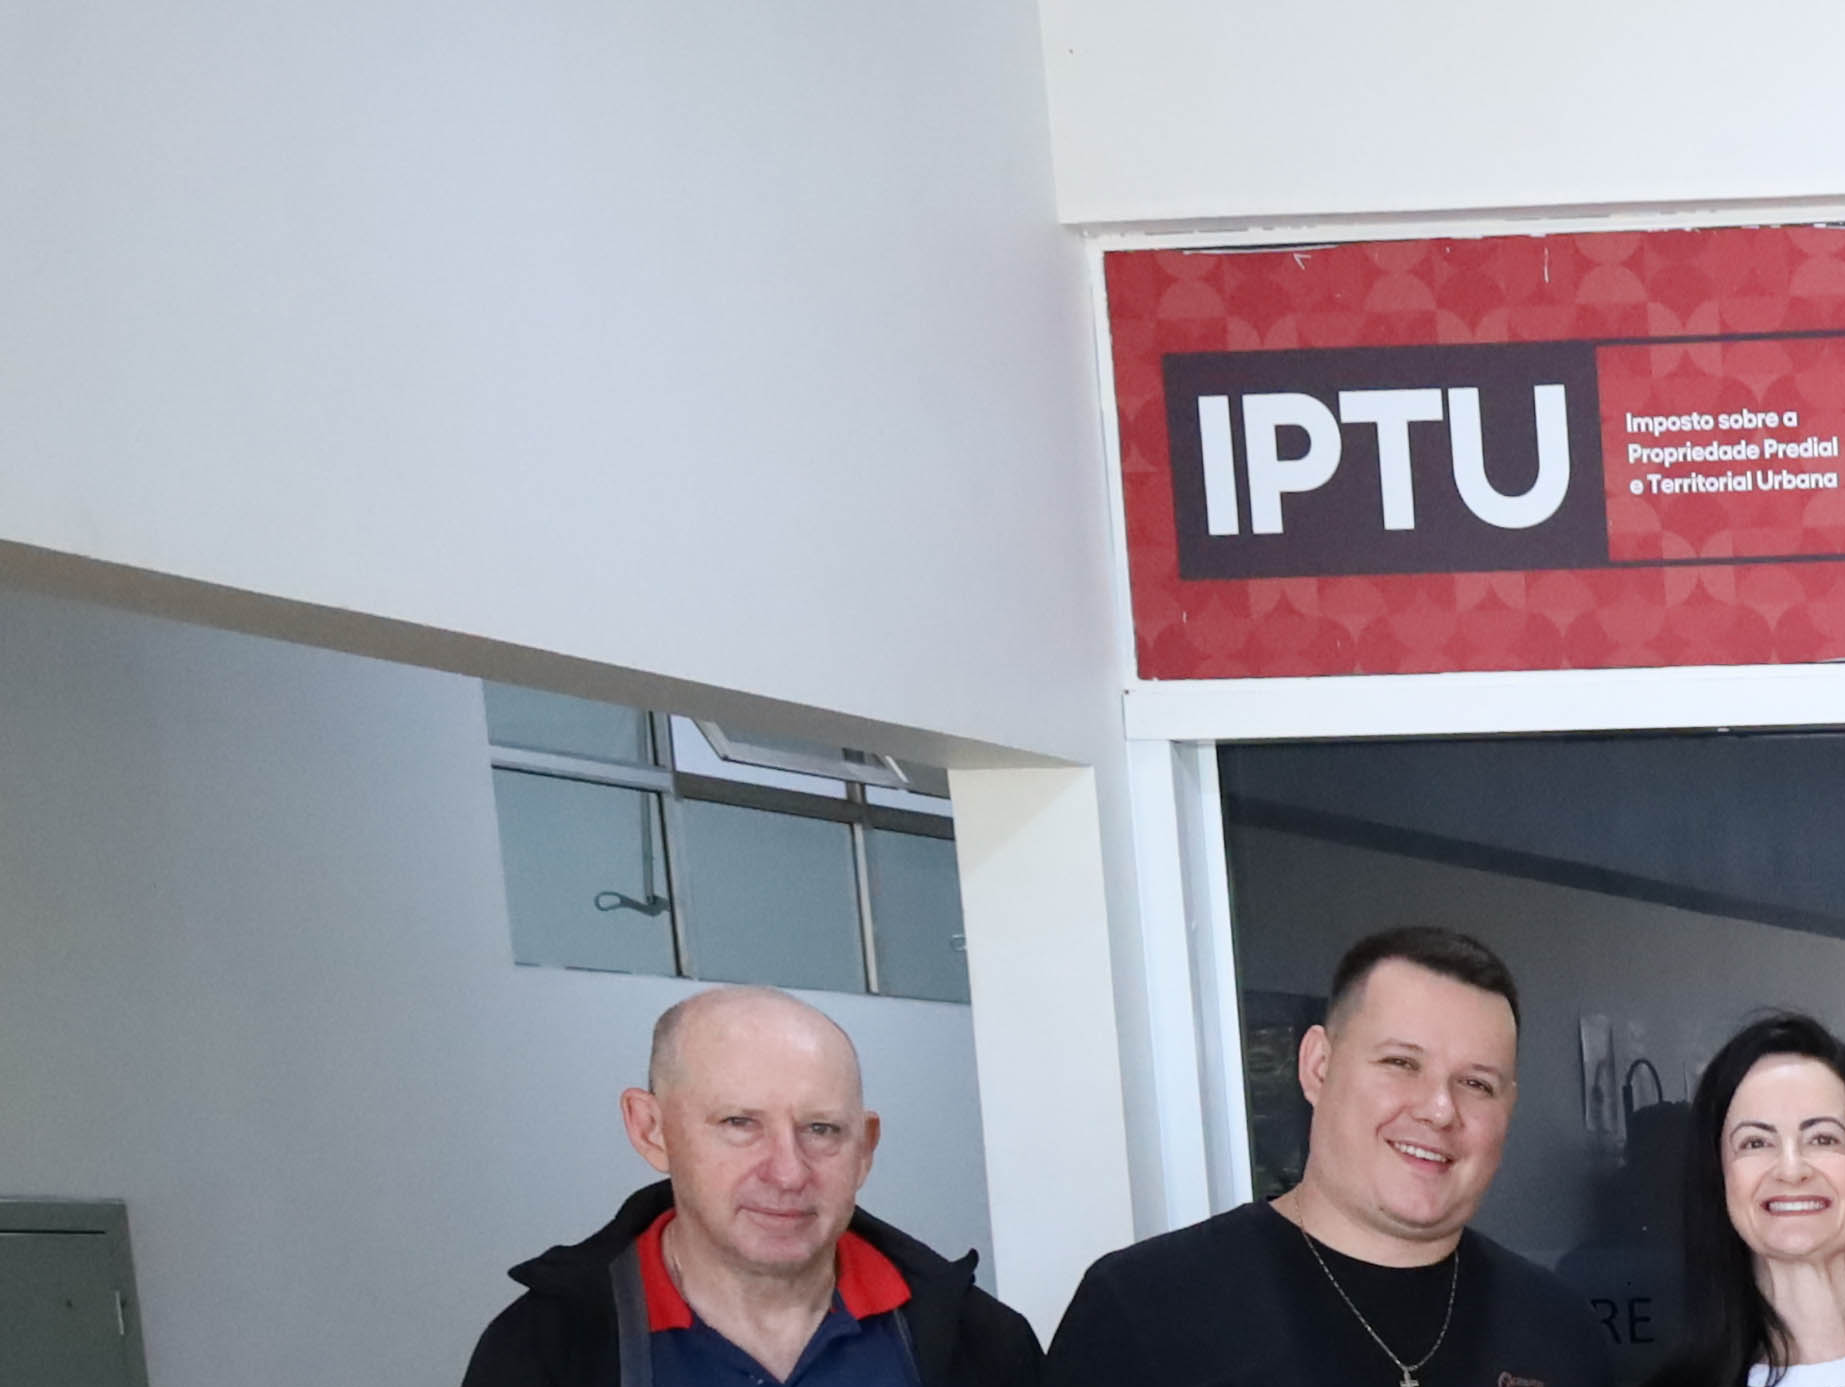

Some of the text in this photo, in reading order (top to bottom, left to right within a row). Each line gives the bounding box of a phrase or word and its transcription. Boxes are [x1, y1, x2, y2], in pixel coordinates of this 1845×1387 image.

[1626, 408, 1798, 437] Imposto sobre a
[1198, 383, 1570, 536] IPTU
[1628, 436, 1838, 467] Propriedade Predial
[1630, 470, 1838, 495] e Territorial Urbana
